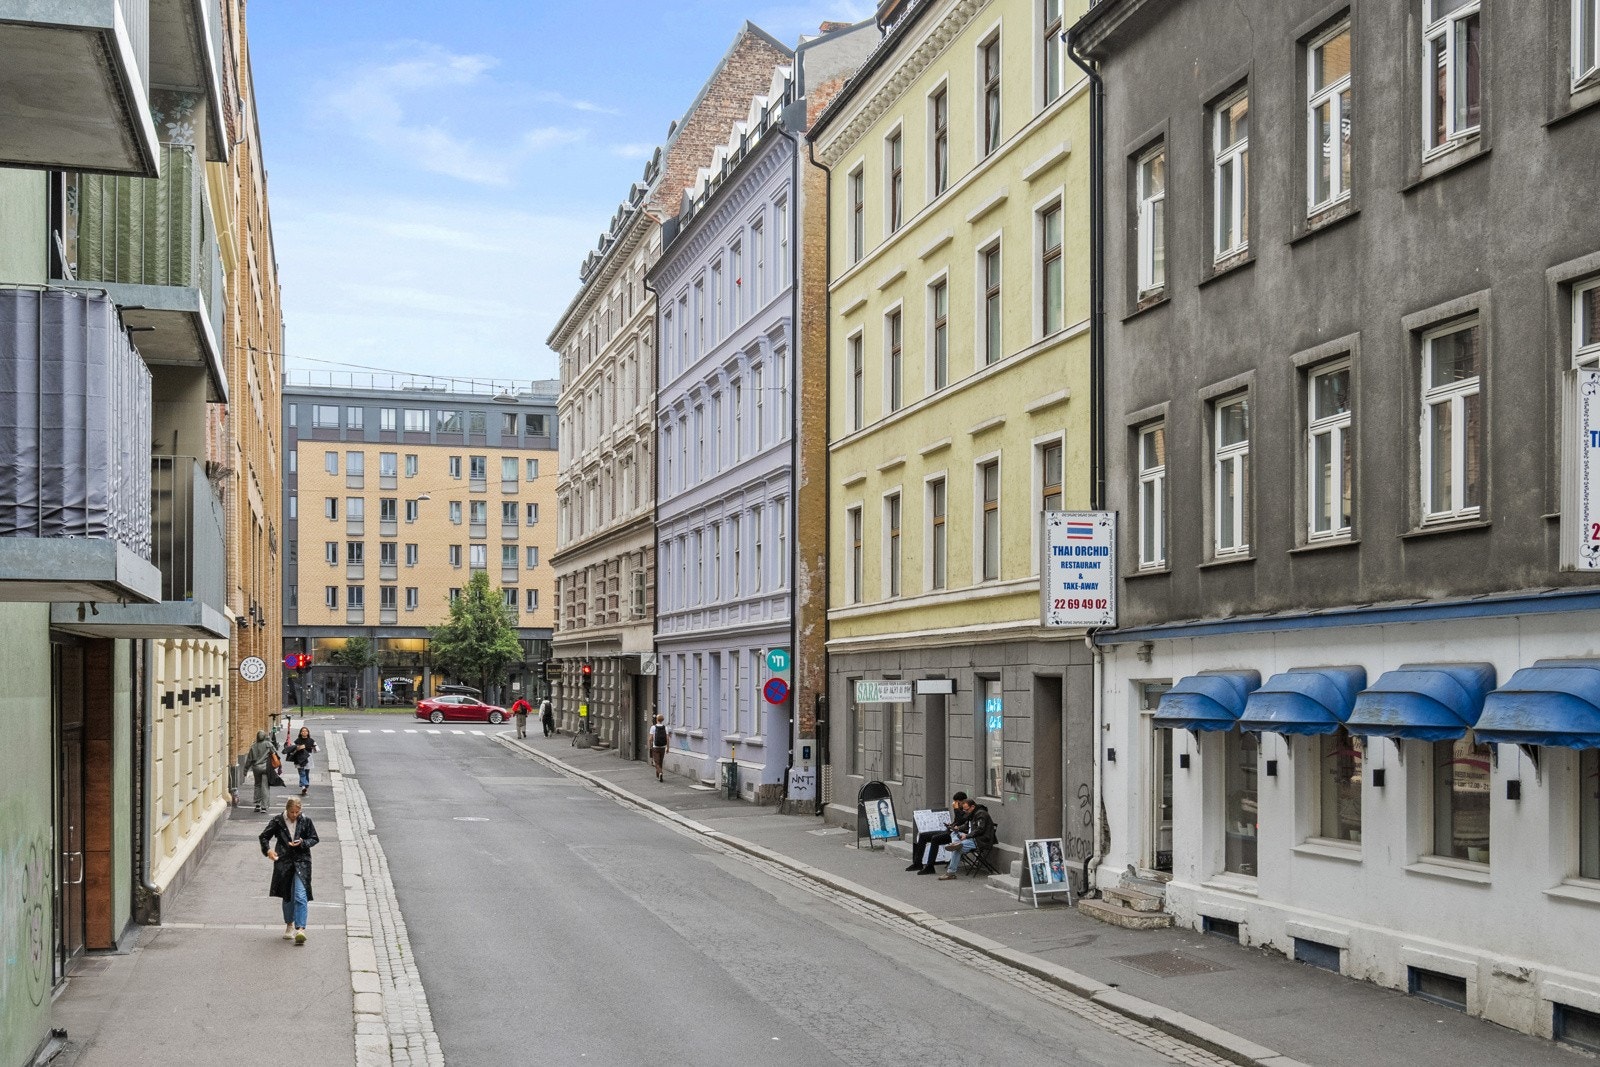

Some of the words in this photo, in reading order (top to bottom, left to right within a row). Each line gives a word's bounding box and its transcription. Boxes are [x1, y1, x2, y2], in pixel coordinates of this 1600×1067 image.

[1590, 431, 1600, 447] T
[1052, 545, 1073, 556] THAI
[1075, 545, 1109, 557] ORCHID
[1060, 561, 1101, 569] RESTAURANT
[1063, 582, 1098, 590] TAKE-AWAY
[1054, 599, 1066, 609] 22
[1067, 599, 1080, 609] 69
[1081, 599, 1094, 609] 49
[1095, 599, 1107, 610] 02
[857, 682, 879, 701] SARA
